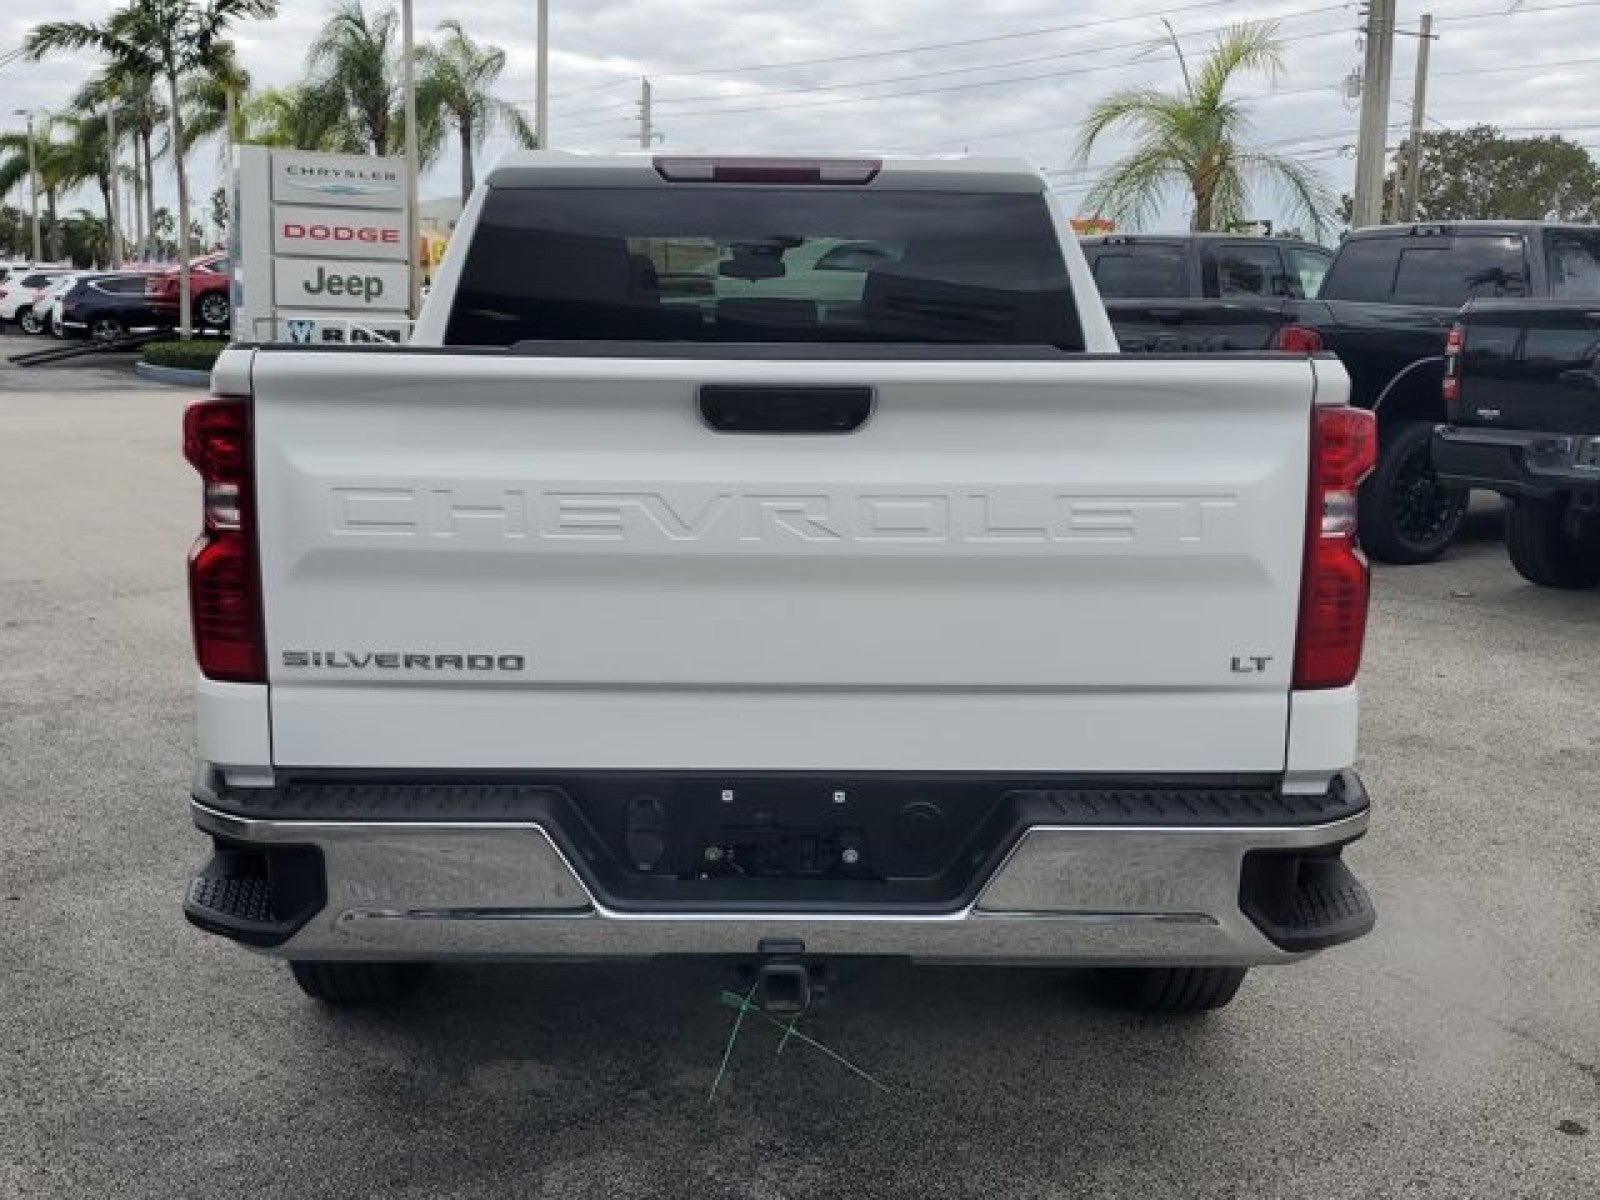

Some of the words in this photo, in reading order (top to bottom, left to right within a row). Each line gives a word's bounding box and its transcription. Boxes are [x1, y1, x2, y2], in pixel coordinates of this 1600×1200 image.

[286, 164, 396, 180] CHRYSLER
[284, 224, 399, 242] DODGE
[303, 266, 383, 302] Jeep
[322, 329, 400, 342] RAM
[329, 486, 1237, 543] CHEVROLET
[282, 651, 525, 670] SILVERADO
[1230, 656, 1273, 672] LT
